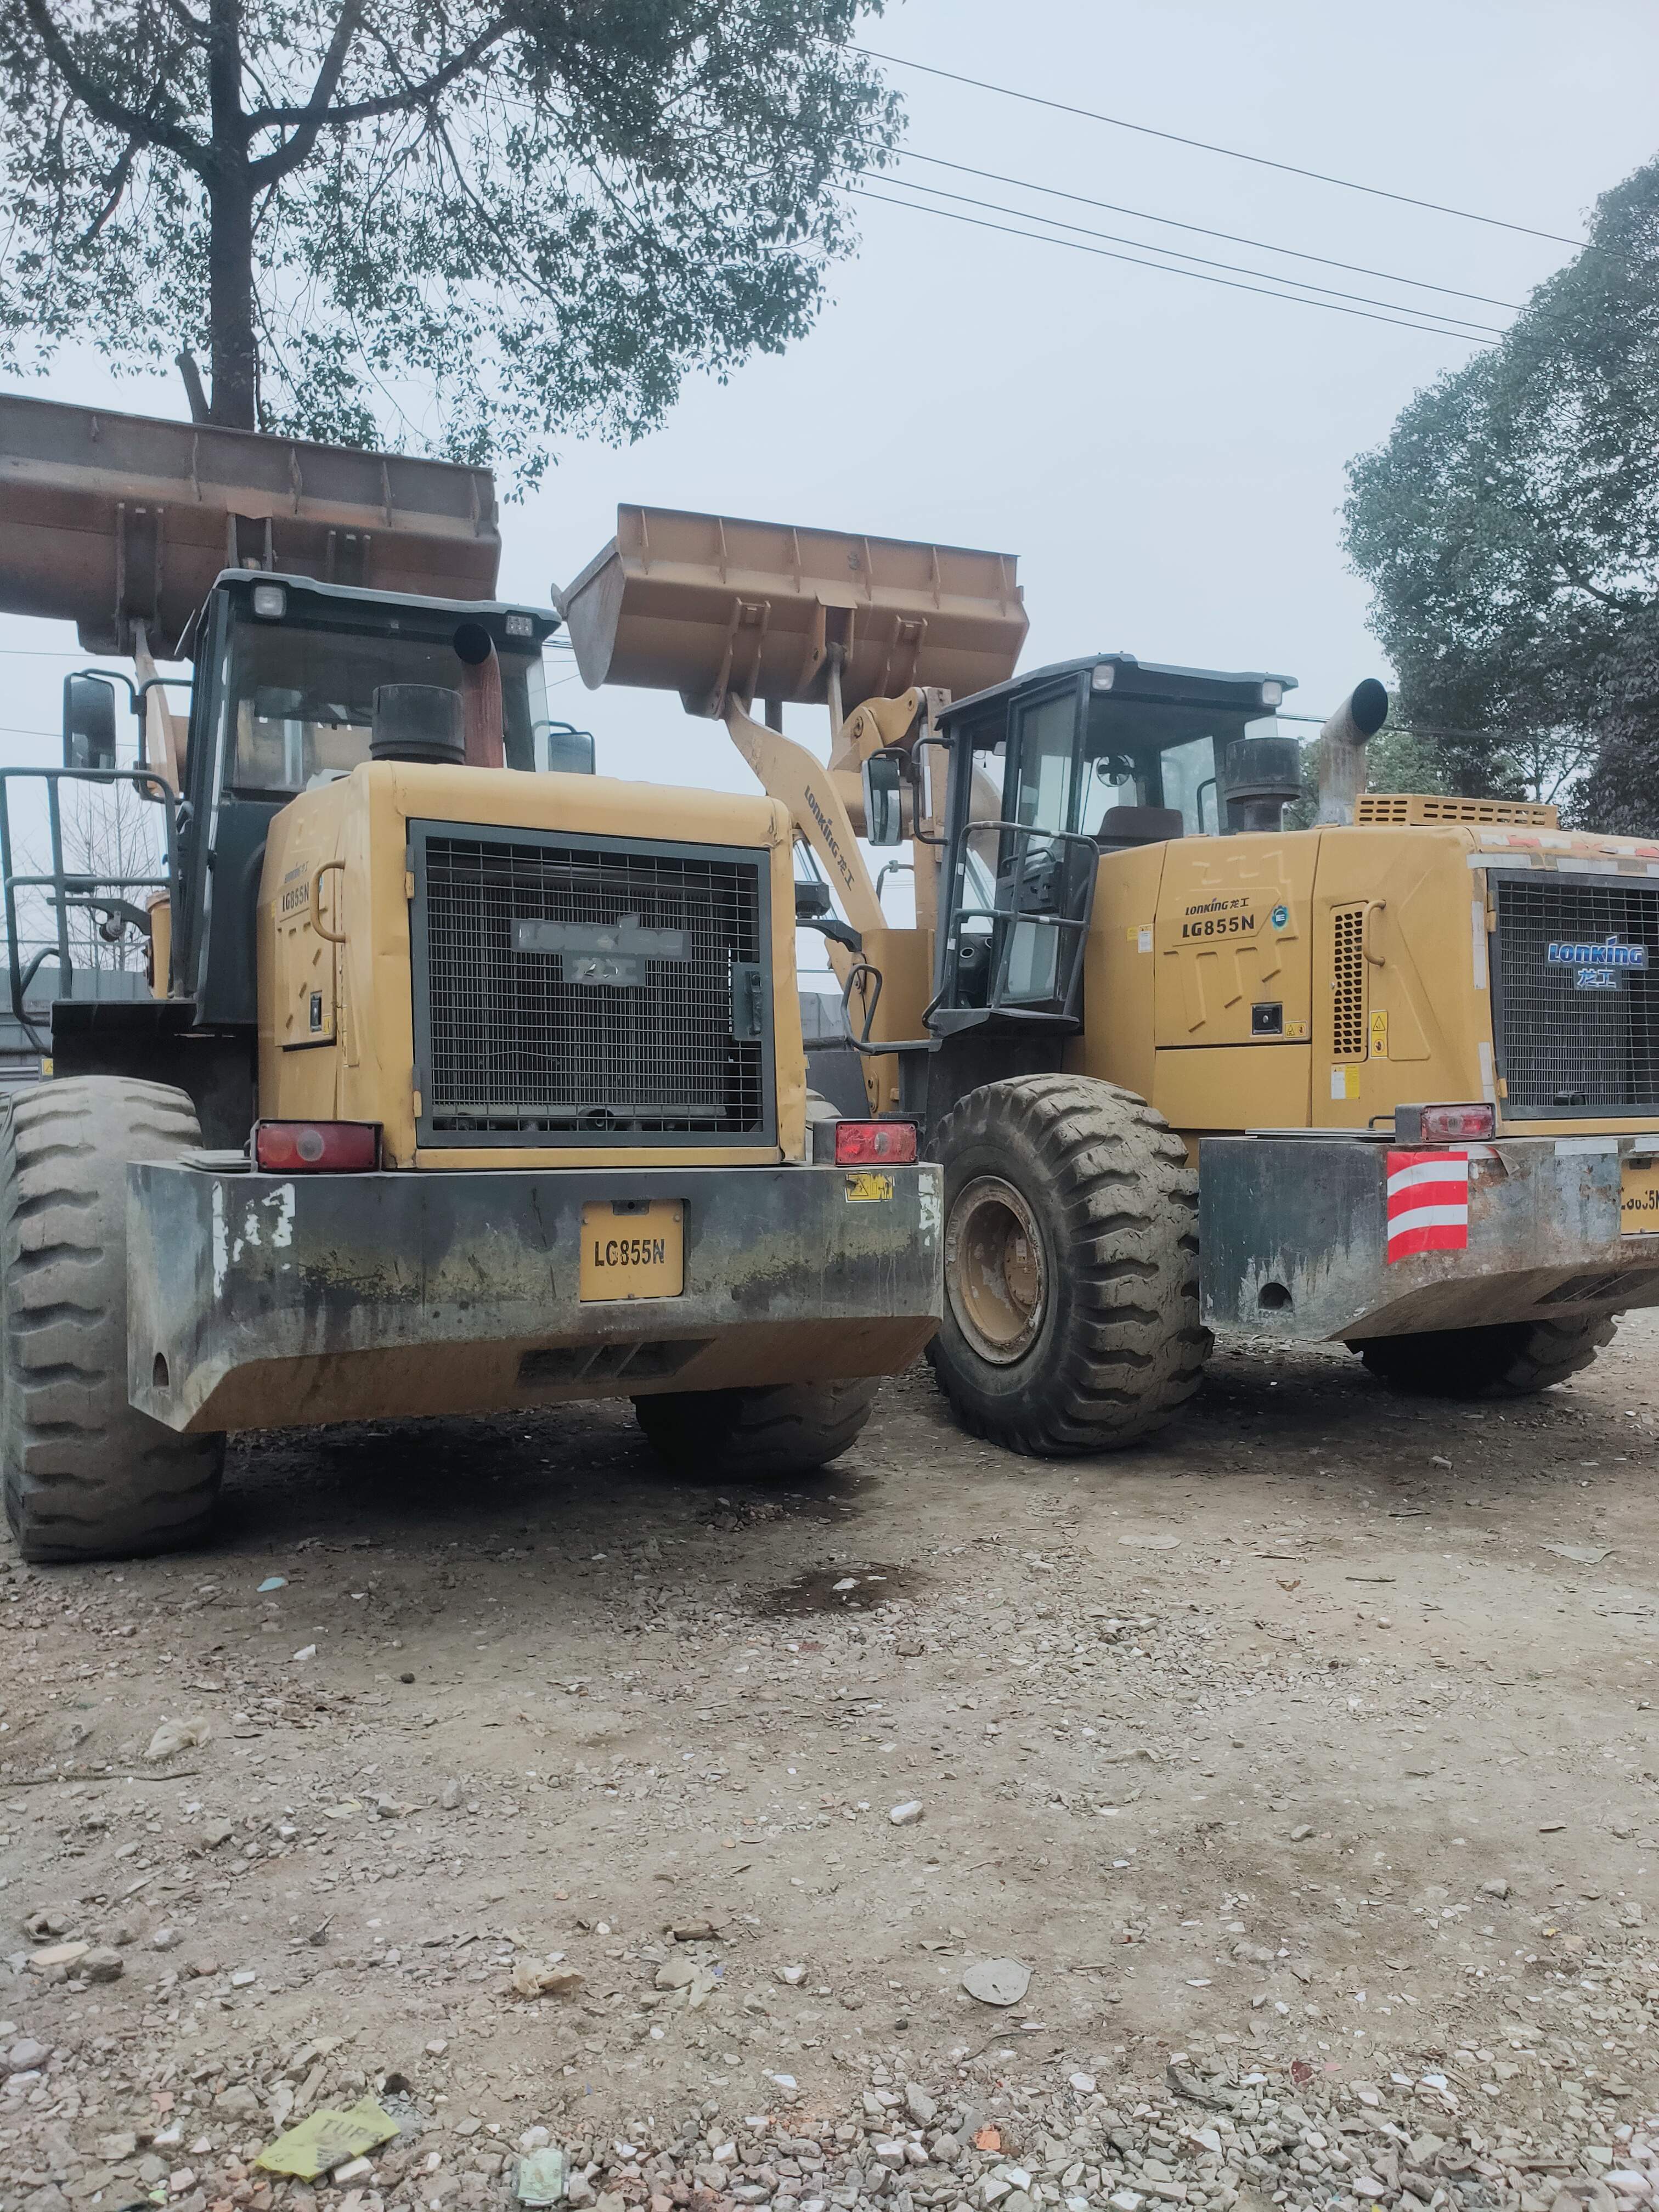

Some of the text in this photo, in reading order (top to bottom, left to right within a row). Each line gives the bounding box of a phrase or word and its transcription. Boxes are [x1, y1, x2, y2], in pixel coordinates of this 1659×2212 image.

[1229, 897, 1250, 909] 龙工
[1182, 914, 1255, 938] LG855N
[1577, 968, 1617, 988] 龙工
